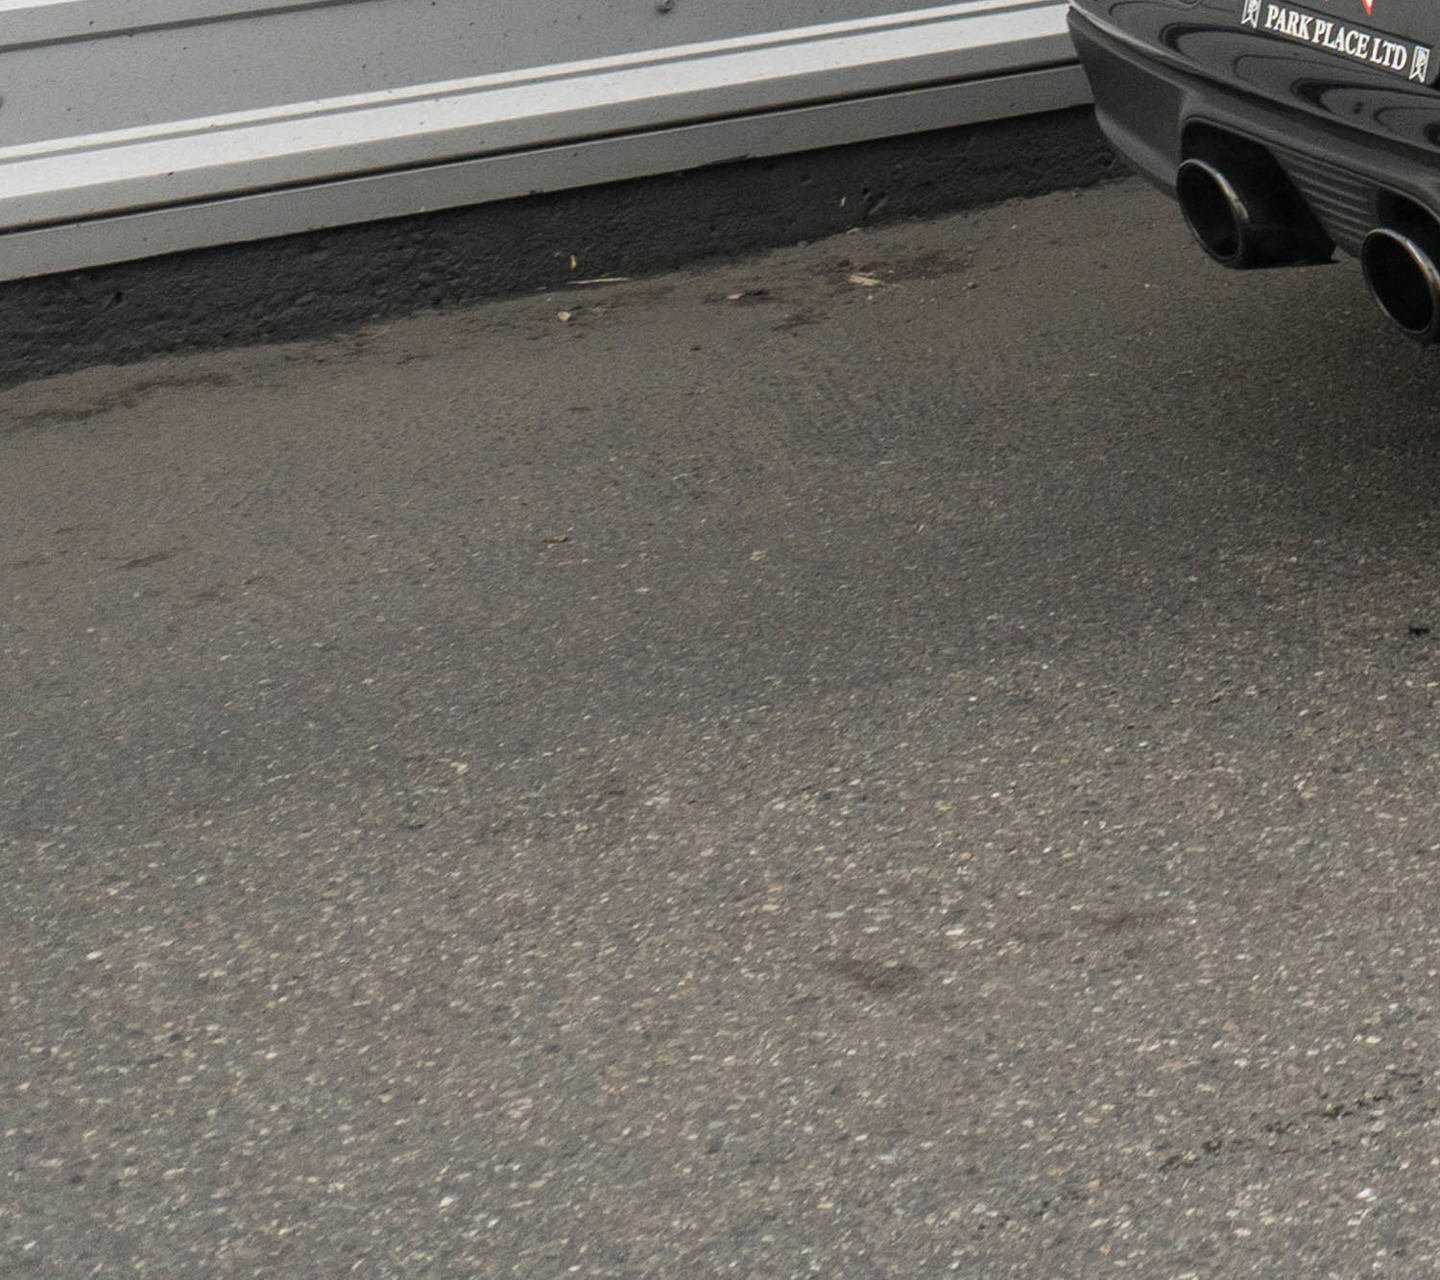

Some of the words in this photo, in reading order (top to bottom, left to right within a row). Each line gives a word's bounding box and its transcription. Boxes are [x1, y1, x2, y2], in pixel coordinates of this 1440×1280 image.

[1264, 4, 1314, 41] PARK
[1312, 18, 1370, 59] PLACE
[1369, 37, 1408, 71] LTD
